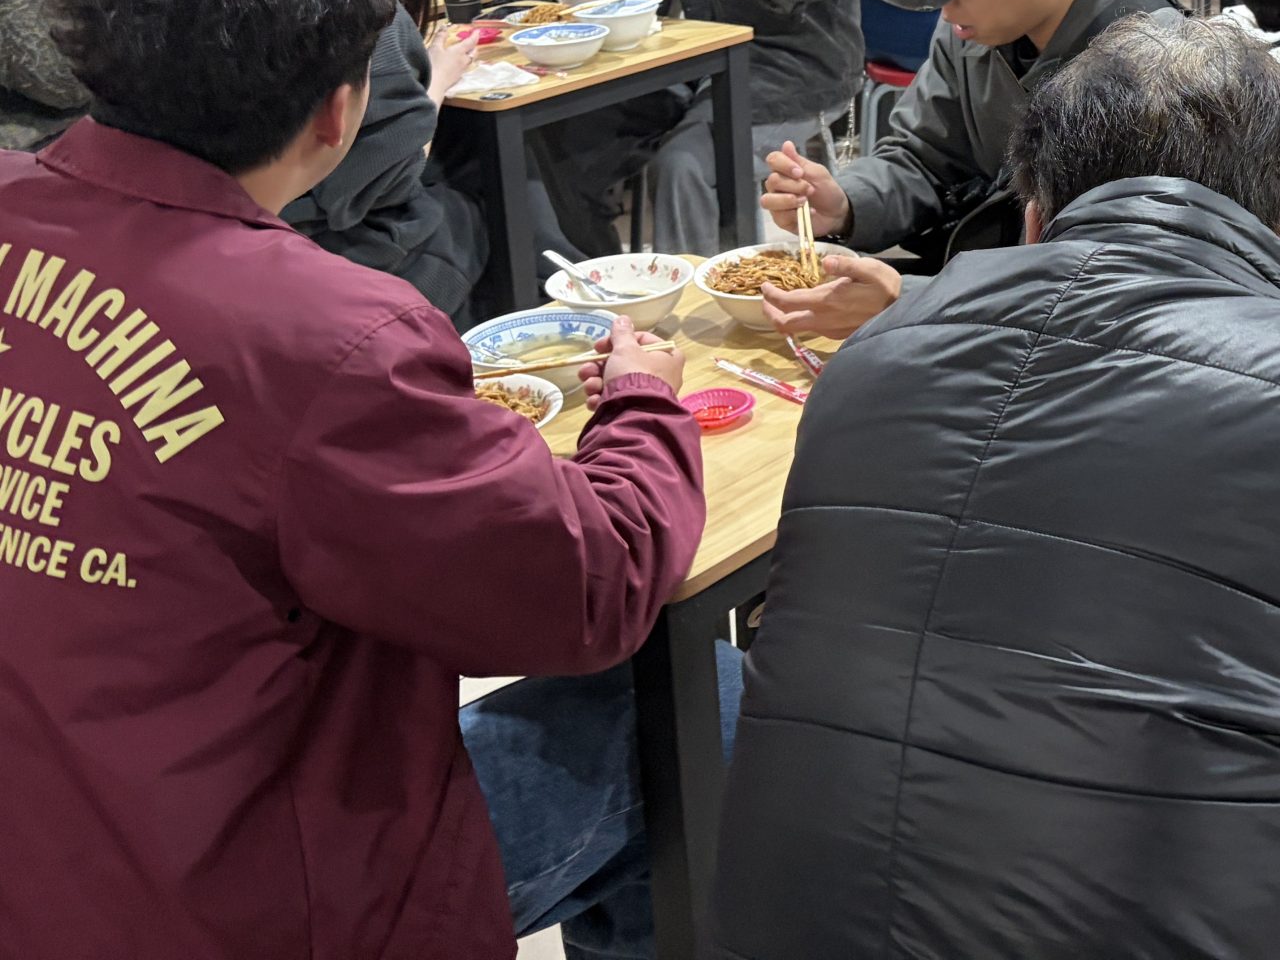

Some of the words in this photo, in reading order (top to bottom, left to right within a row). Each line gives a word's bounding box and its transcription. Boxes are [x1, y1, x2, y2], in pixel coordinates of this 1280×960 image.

[3, 248, 225, 464] MACHINA
[0, 464, 70, 527] VICE
[80, 548, 137, 588] CA.
